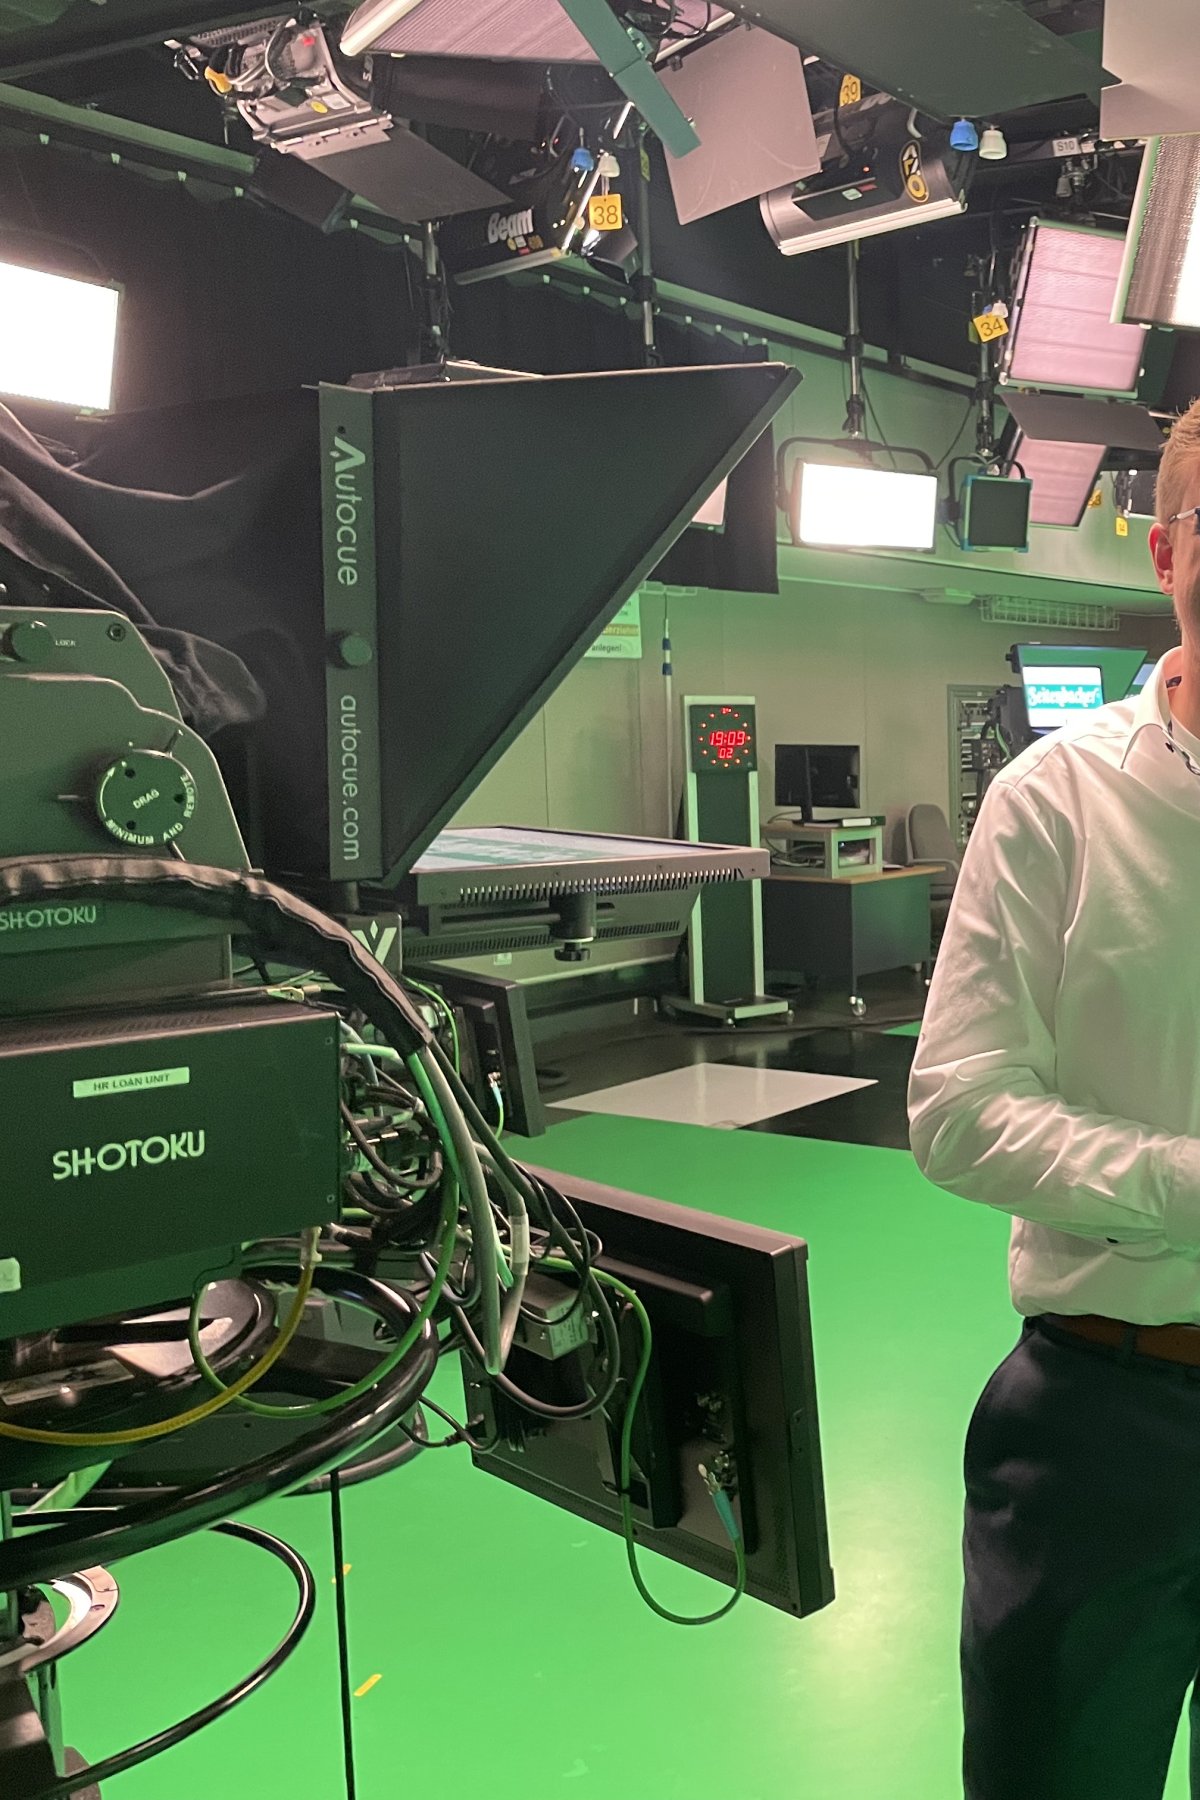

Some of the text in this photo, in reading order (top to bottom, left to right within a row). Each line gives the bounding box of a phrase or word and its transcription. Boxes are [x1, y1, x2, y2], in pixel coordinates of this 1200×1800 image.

[1057, 139, 1075, 152] S10
[487, 206, 534, 244] Beam
[593, 204, 619, 226] 38
[980, 318, 1004, 337] 34
[333, 436, 366, 586] Autocue
[709, 730, 746, 746] 19:09
[718, 747, 734, 759] 02
[340, 695, 361, 861] autocue.com
[105, 774, 195, 845] MINIMUM AND REMOTE
[133, 788, 160, 809] DRAG
[0, 905, 96, 931] SHOTOKU
[93, 1073, 171, 1091] HR LOAN UNIT
[53, 1130, 205, 1180] SHOTOKU
